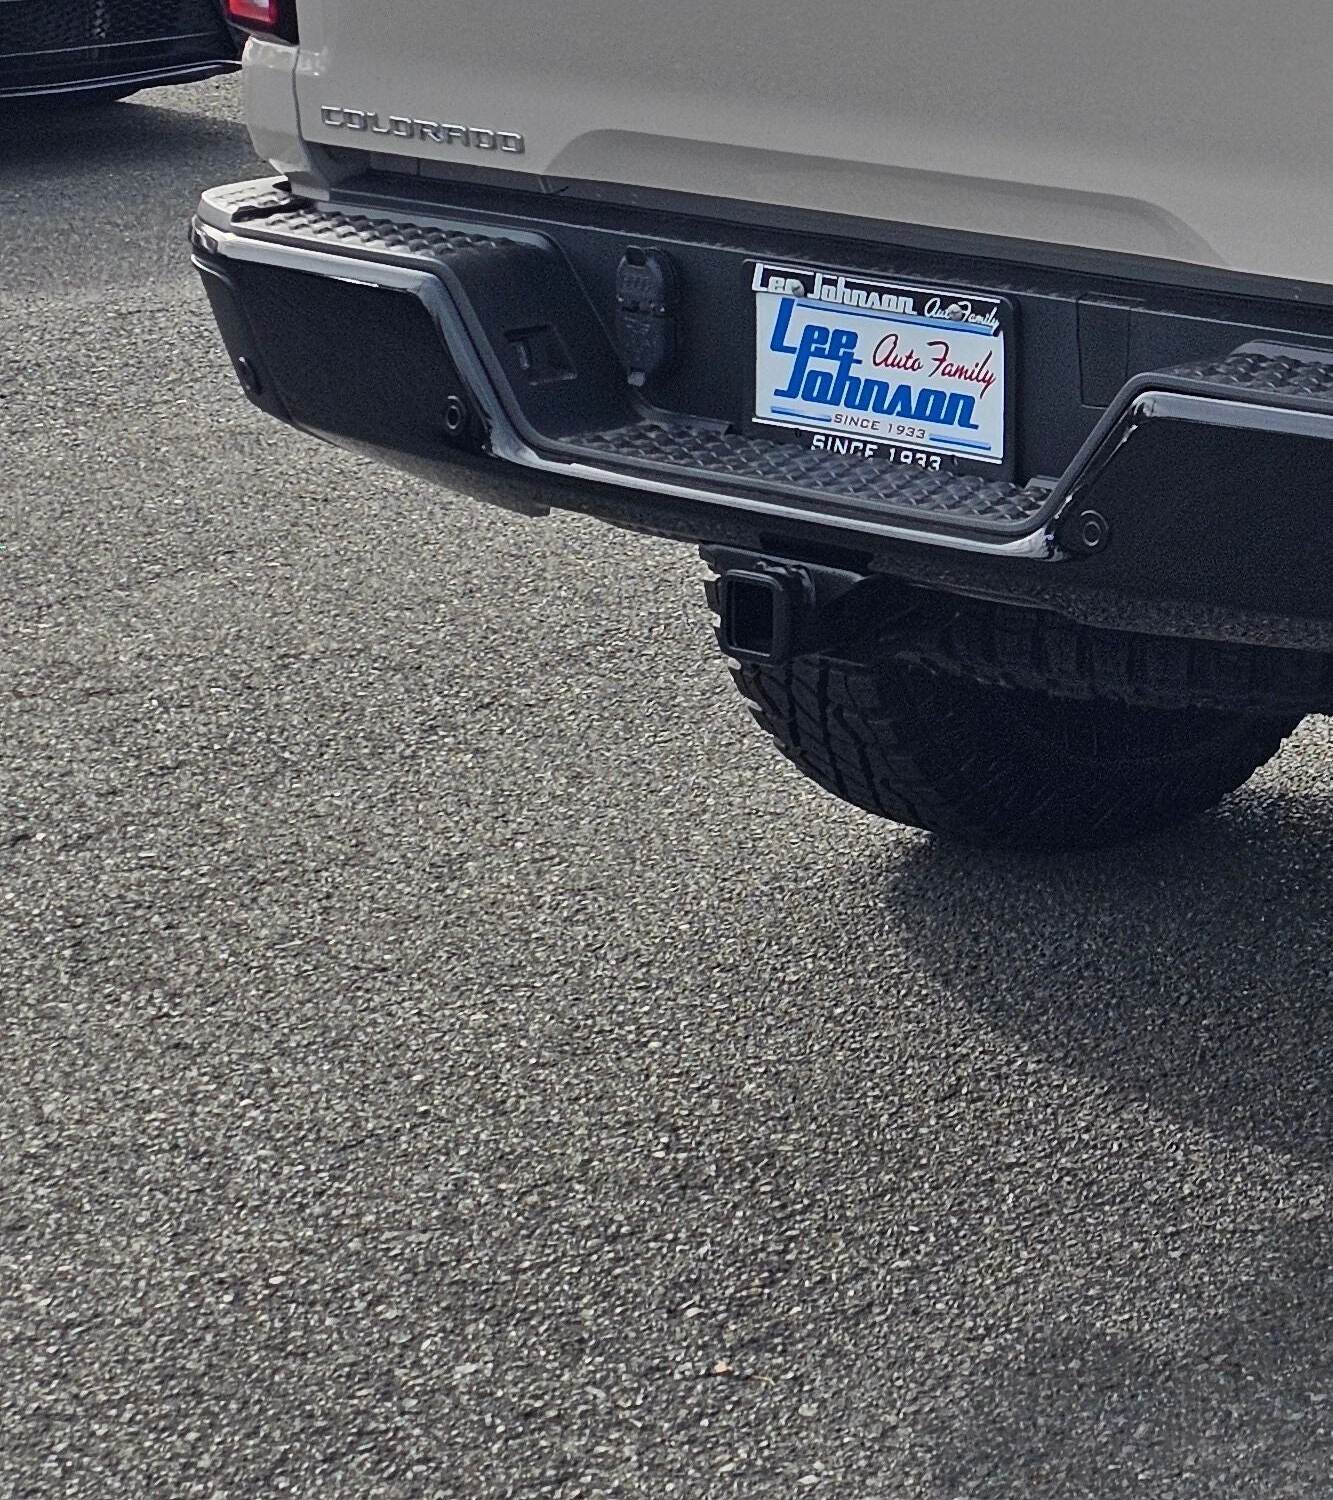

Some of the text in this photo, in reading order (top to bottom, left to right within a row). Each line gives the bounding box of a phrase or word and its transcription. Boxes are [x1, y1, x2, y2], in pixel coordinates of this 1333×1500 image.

[320, 105, 525, 154] COLORADO
[807, 273, 918, 315] Johnson
[957, 301, 1001, 336] Family
[769, 297, 997, 400] Lee Auto Family
[773, 354, 979, 430] Johnson
[833, 413, 926, 439] SINCE 1933
